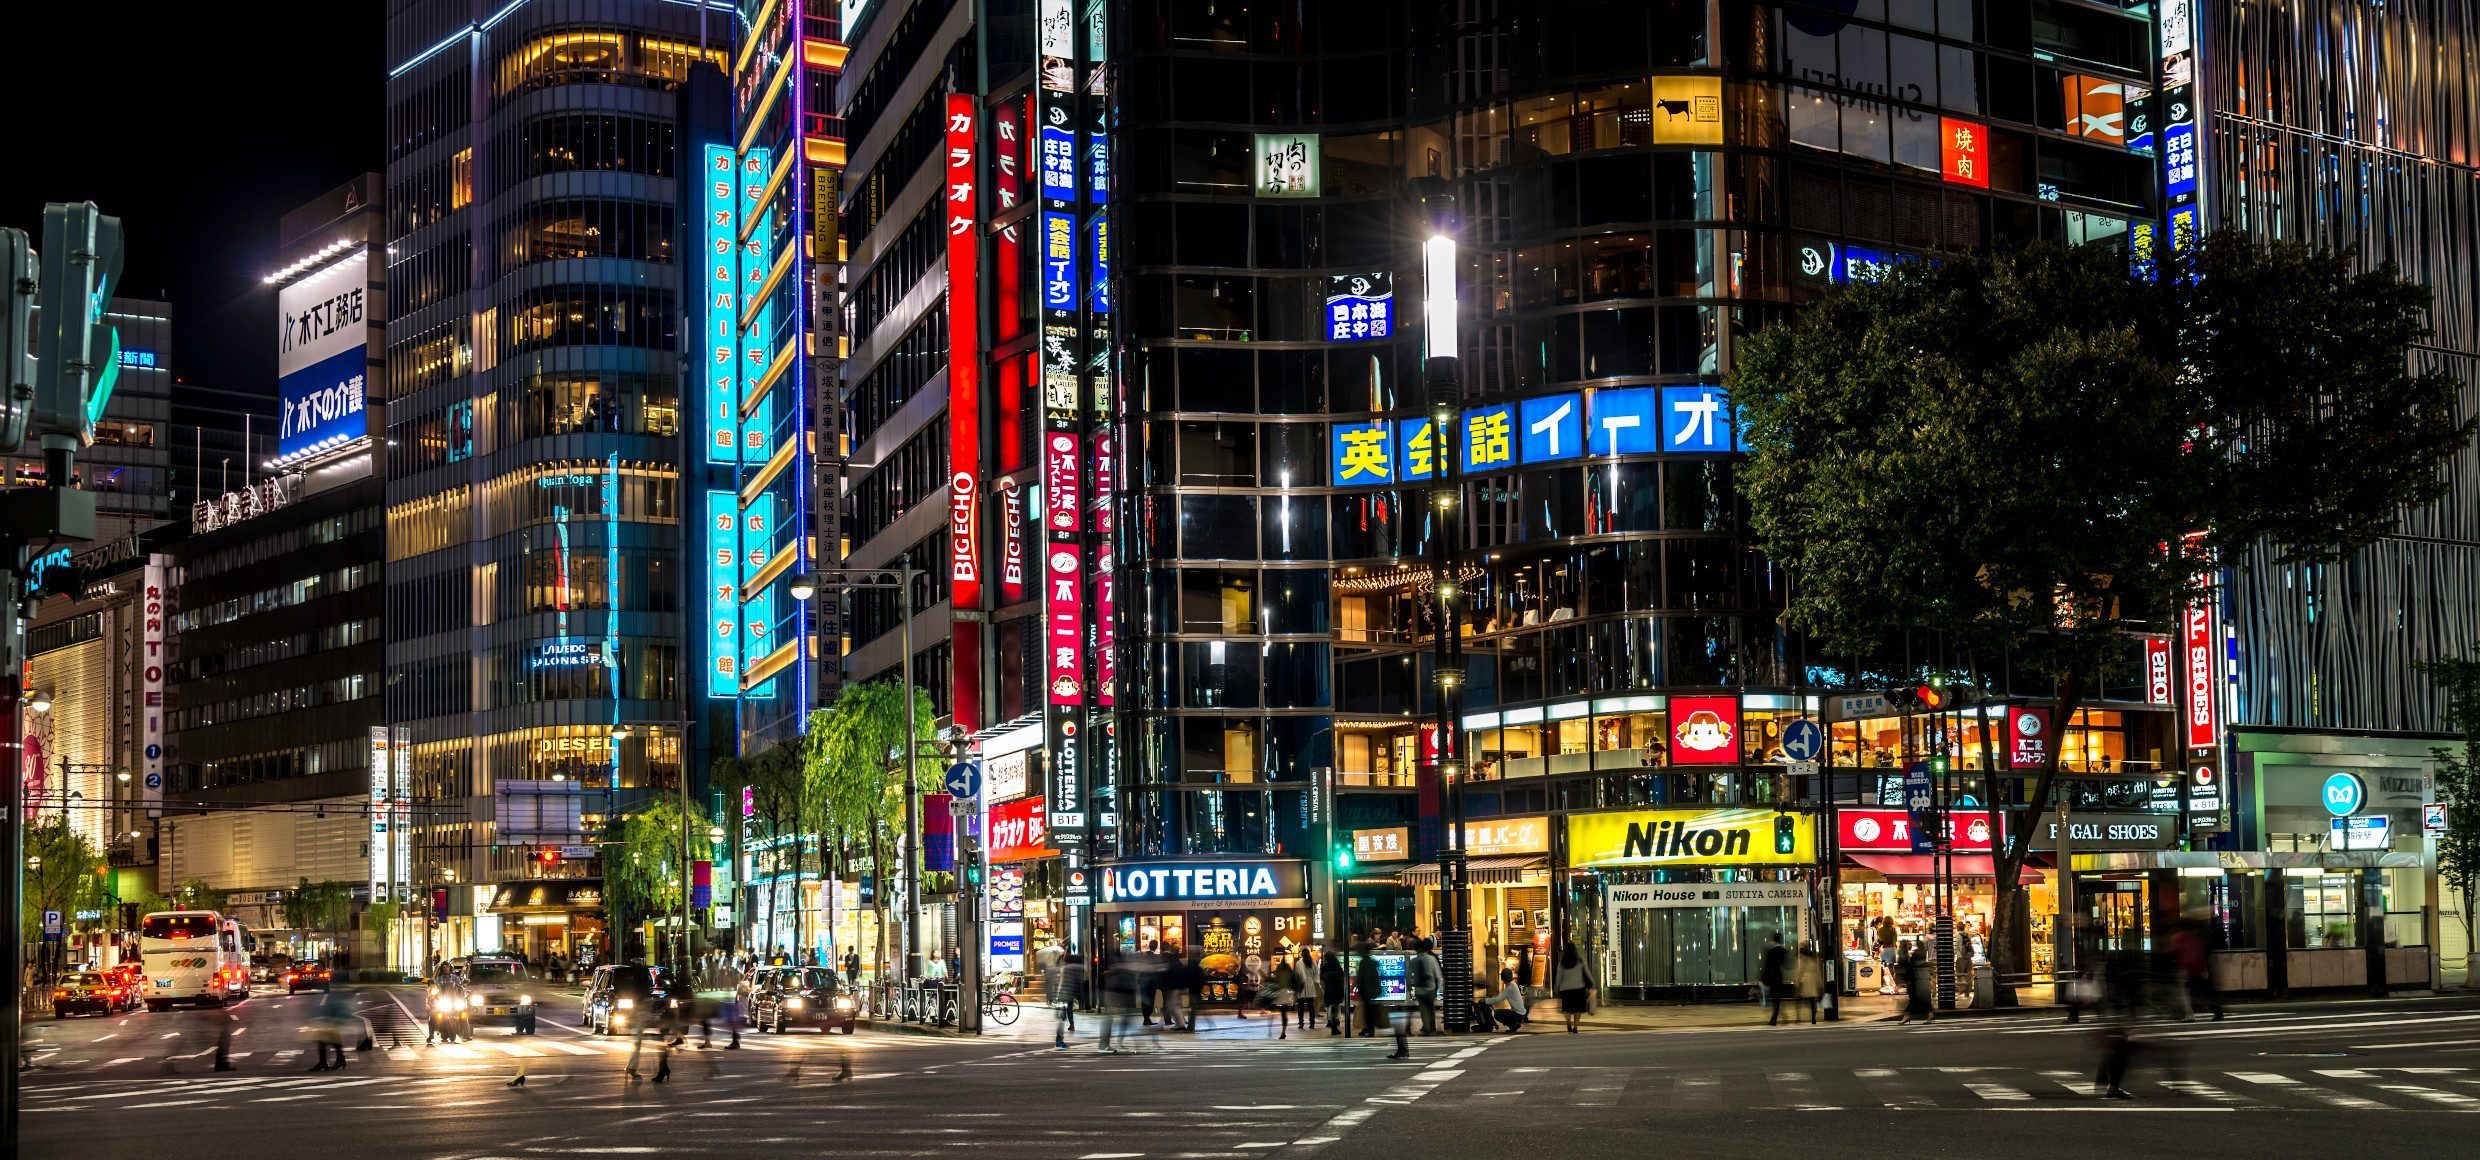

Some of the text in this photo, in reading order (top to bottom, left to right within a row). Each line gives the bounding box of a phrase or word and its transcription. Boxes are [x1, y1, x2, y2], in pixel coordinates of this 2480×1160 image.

[1954, 127, 1975, 180] 焼肉
[949, 113, 974, 236] カラオケ
[817, 175, 826, 242] BREITLING
[826, 176, 835, 222] STUDIO
[1049, 217, 1071, 305] 英会話イーオン
[299, 287, 363, 347] 木下工務店
[297, 374, 364, 433] 木下の介護
[1050, 453, 1061, 510] レストラン
[717, 514, 734, 673] カラオケ館
[1055, 580, 1075, 669] 不二家
[540, 737, 615, 752] DIESEL
[2018, 739, 2043, 751] 不二家
[1063, 738, 1076, 811] LOTTERIA
[2380, 775, 2422, 793] MIZUH
[992, 817, 1026, 850] カラオケ
[1057, 815, 1078, 825] B1F
[2108, 824, 2158, 840] SHOES
[1623, 820, 1751, 858] Nikon
[1115, 868, 1277, 898] LOTTERIA
[1612, 889, 1696, 902] Nikon House
[1725, 889, 1804, 899] SUKIYA CAMERA
[48, 912, 58, 925] P
[1190, 900, 1215, 909] Burger
[1274, 916, 1307, 931] B1F
[1203, 931, 1234, 948] 絶品
[1244, 935, 1262, 948] 45
